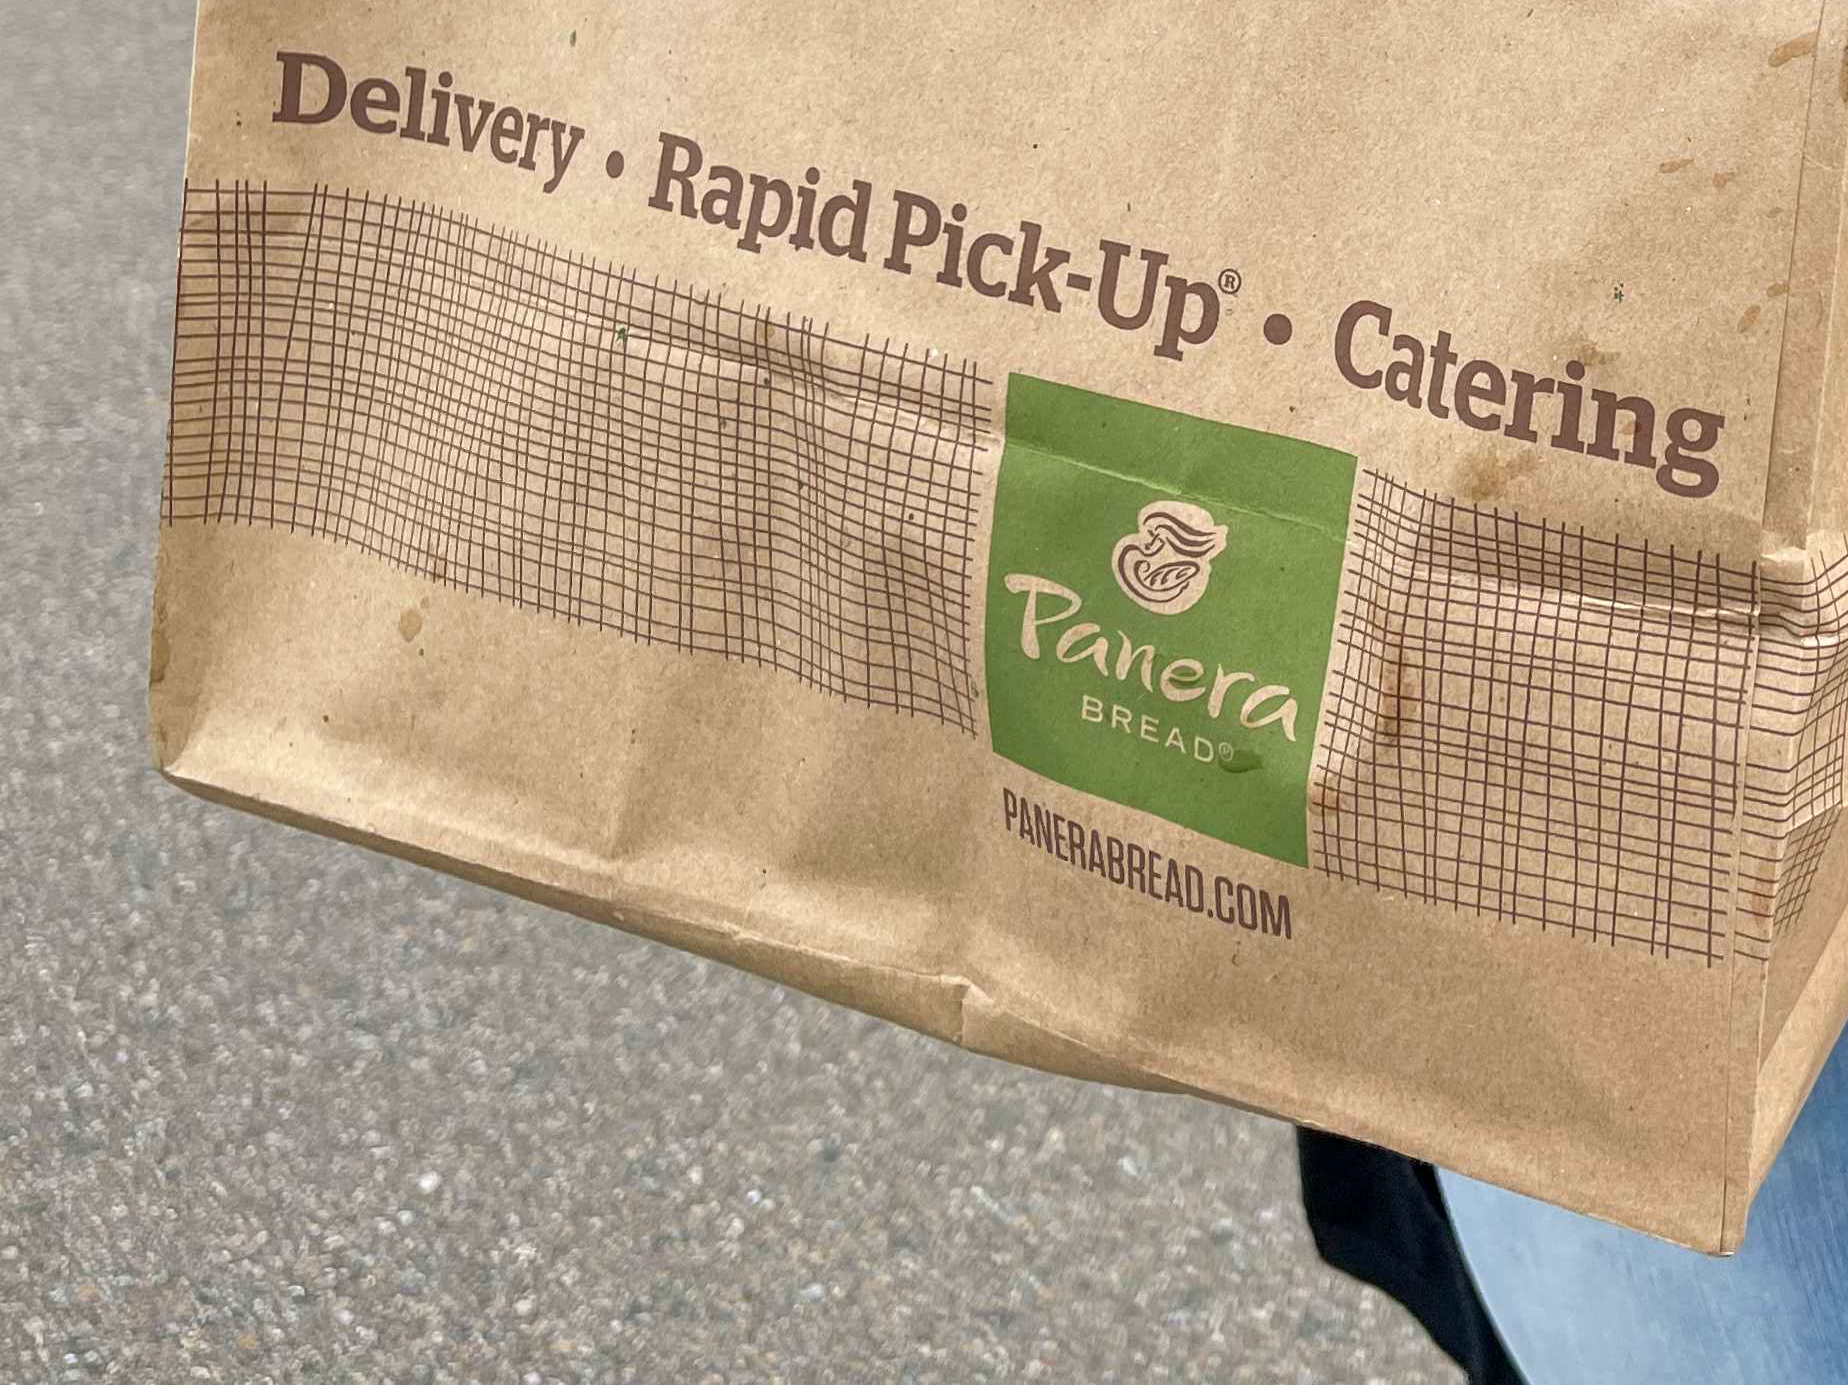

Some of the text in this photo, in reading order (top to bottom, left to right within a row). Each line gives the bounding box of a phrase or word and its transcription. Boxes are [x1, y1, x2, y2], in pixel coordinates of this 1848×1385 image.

[271, 50, 586, 194] Delivery
[647, 130, 873, 264] Rapid
[1333, 299, 1725, 499] Catering
[1003, 572, 1298, 742] Panera
[1002, 787, 1293, 941] PANERABREAD.COM
